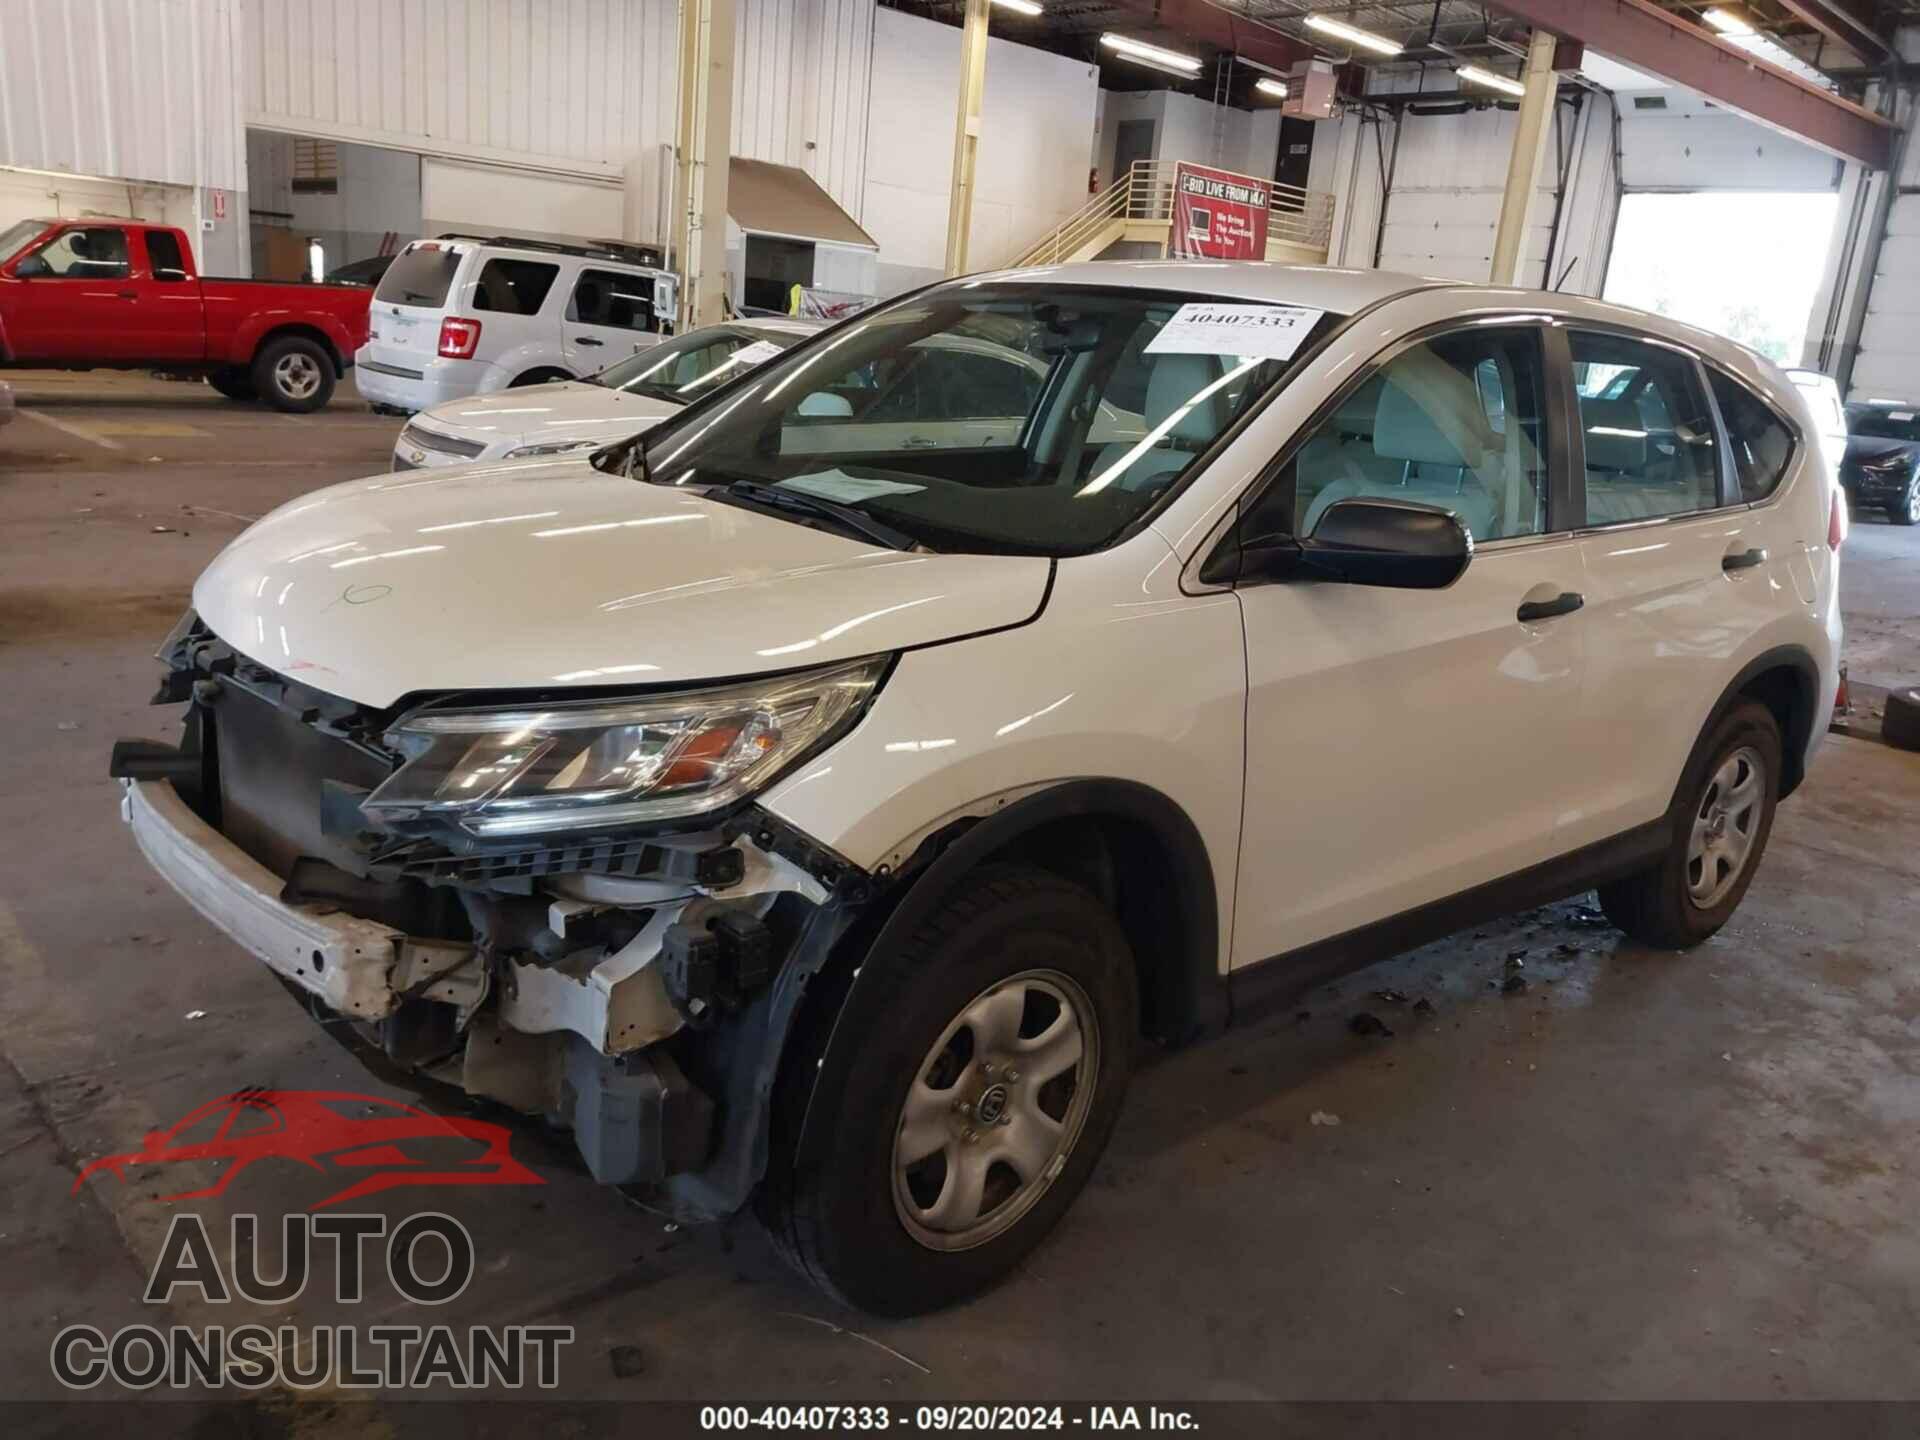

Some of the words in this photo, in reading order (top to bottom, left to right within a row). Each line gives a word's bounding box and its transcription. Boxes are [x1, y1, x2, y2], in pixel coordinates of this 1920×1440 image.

[1206, 181, 1224, 197] LIVE
[1225, 185, 1249, 201] FROM
[1216, 223, 1227, 234] The
[1184, 314, 1295, 327] 40407333
